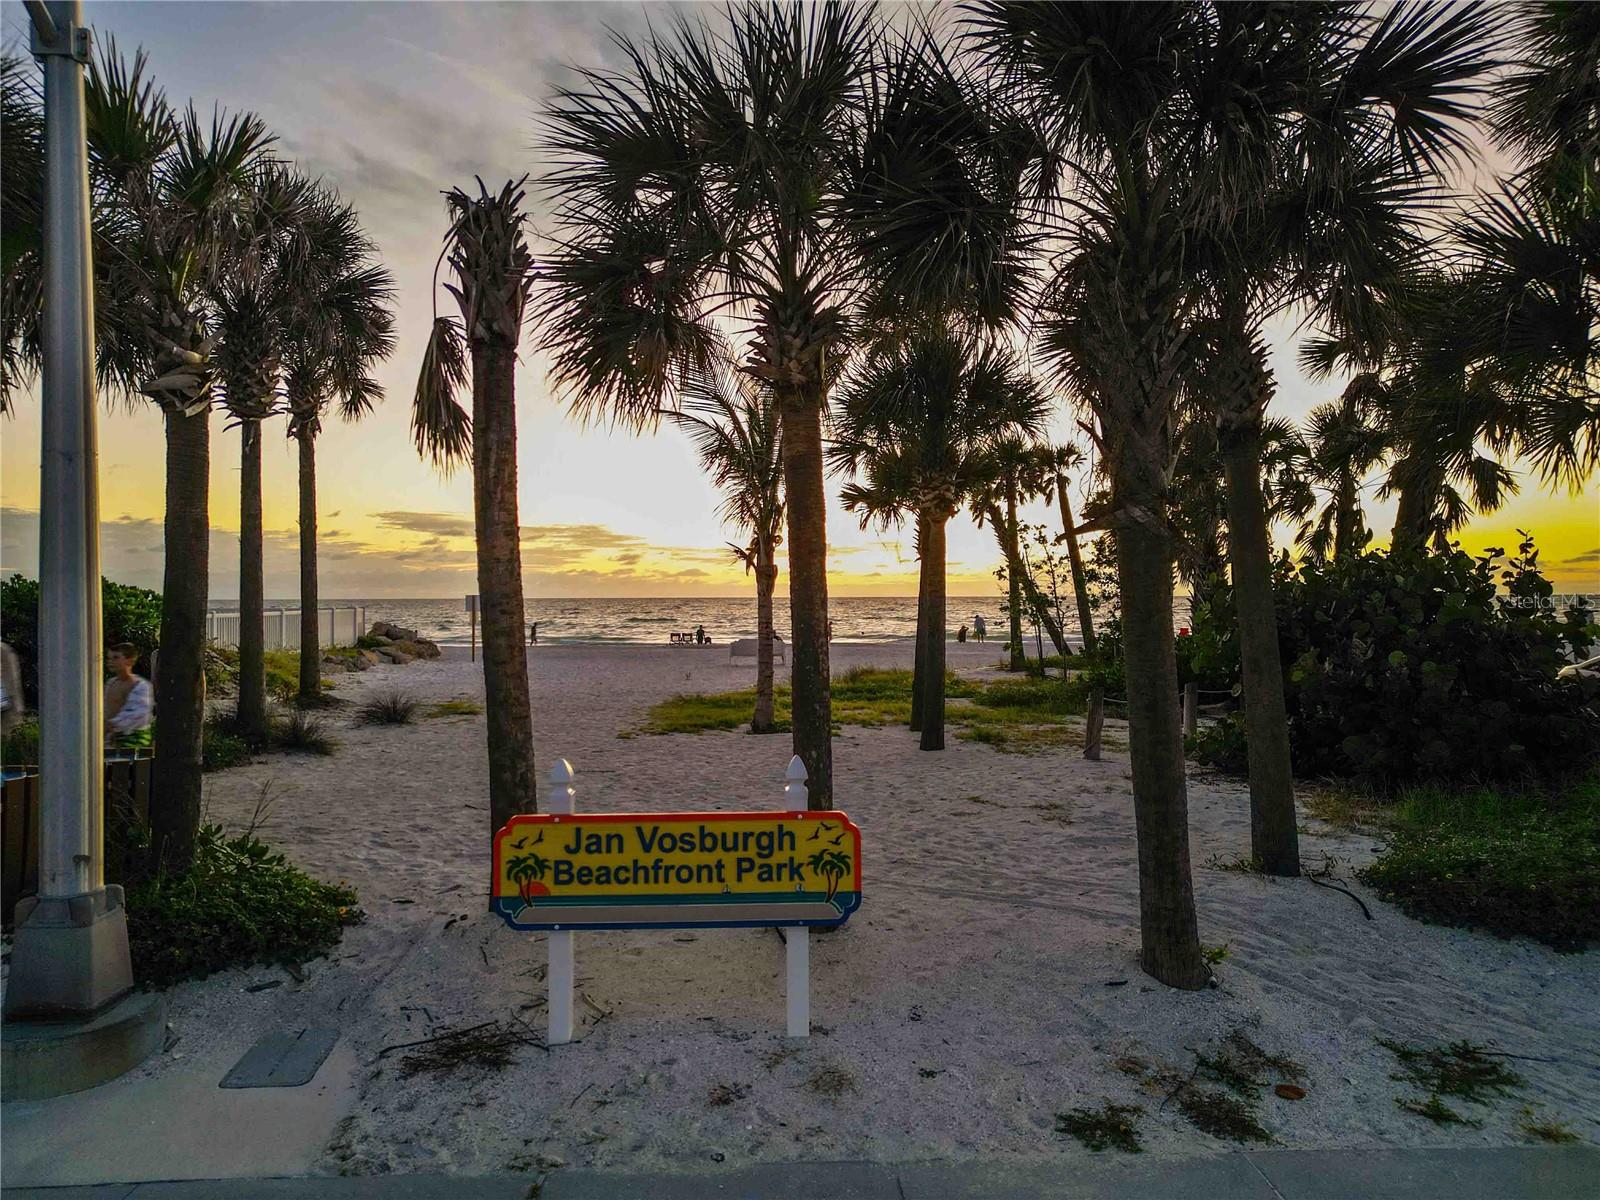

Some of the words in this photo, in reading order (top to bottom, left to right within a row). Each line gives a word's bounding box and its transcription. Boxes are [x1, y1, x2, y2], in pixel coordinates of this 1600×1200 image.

[564, 826, 624, 854] Jan
[635, 824, 797, 857] Vosburgh
[553, 859, 726, 885] Beachfront
[736, 856, 806, 883] Park
